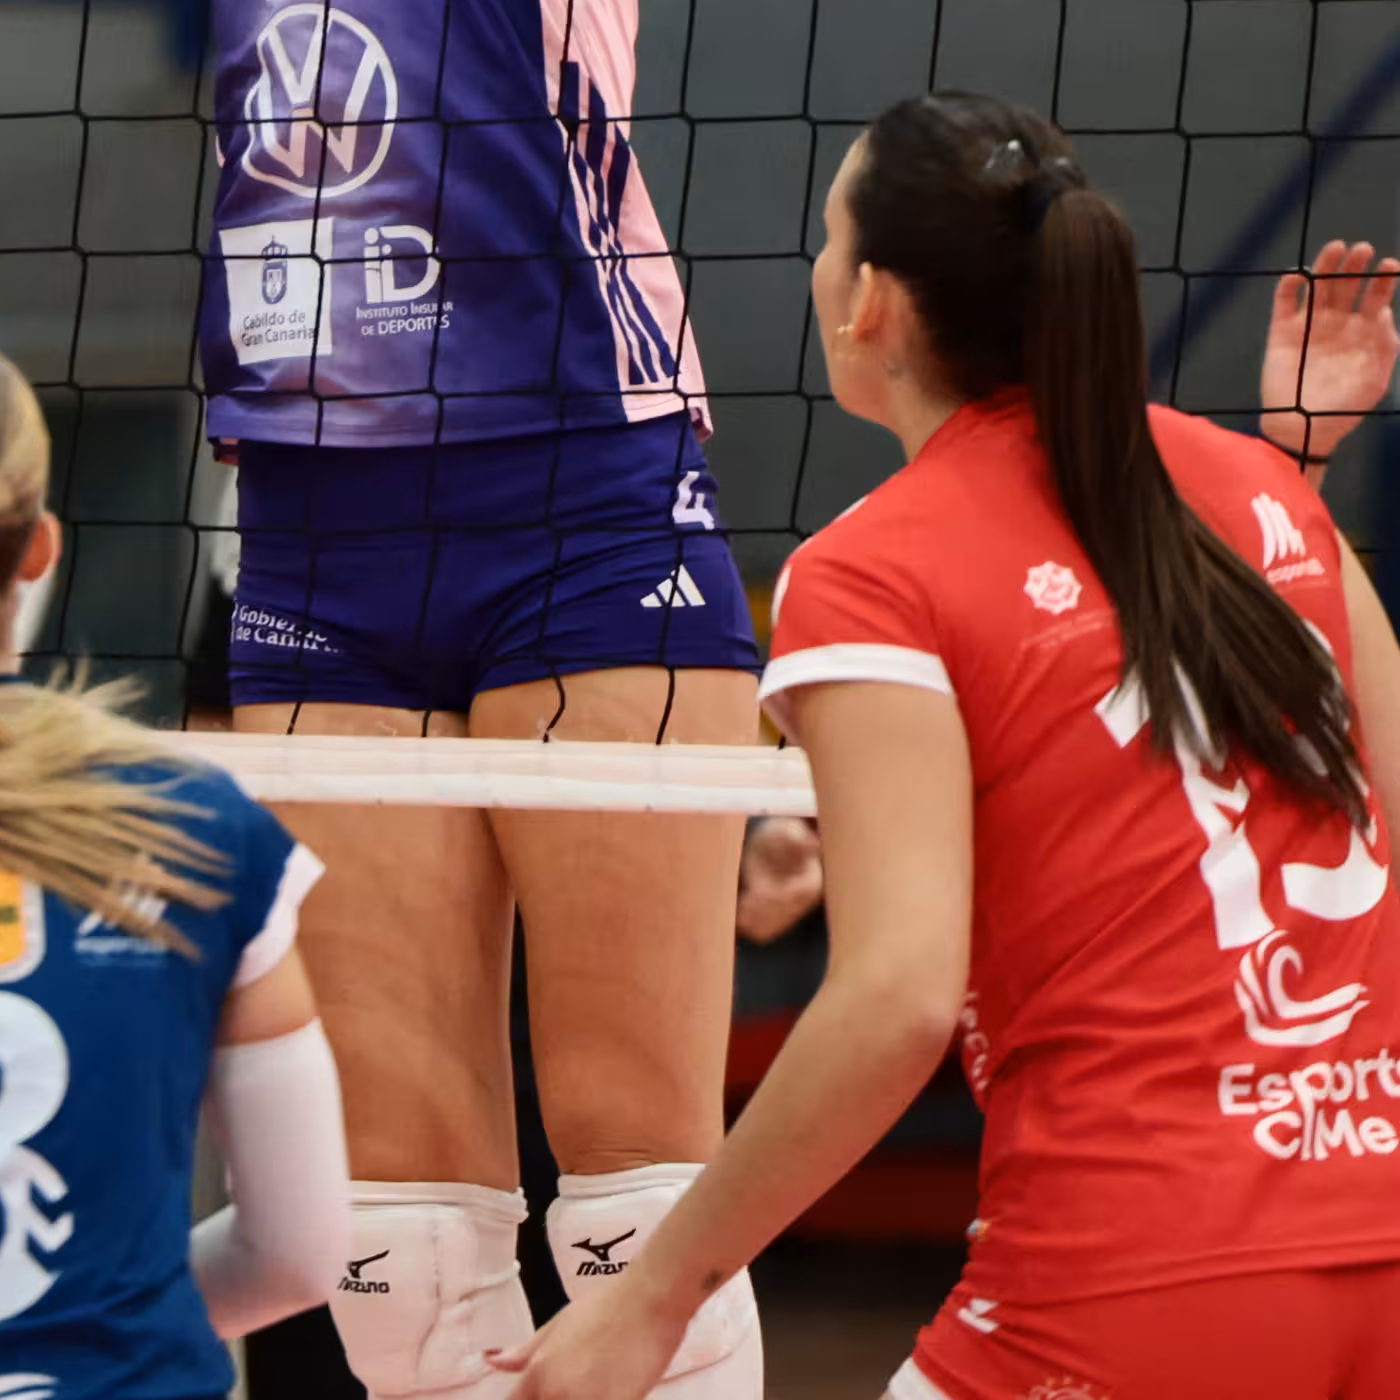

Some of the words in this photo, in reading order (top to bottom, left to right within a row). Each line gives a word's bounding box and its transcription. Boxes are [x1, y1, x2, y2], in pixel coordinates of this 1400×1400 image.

[243, 311, 286, 331] Cabildo
[288, 308, 307, 326] de
[241, 329, 265, 347] Gran
[1217, 1047, 1400, 1117] Esport
